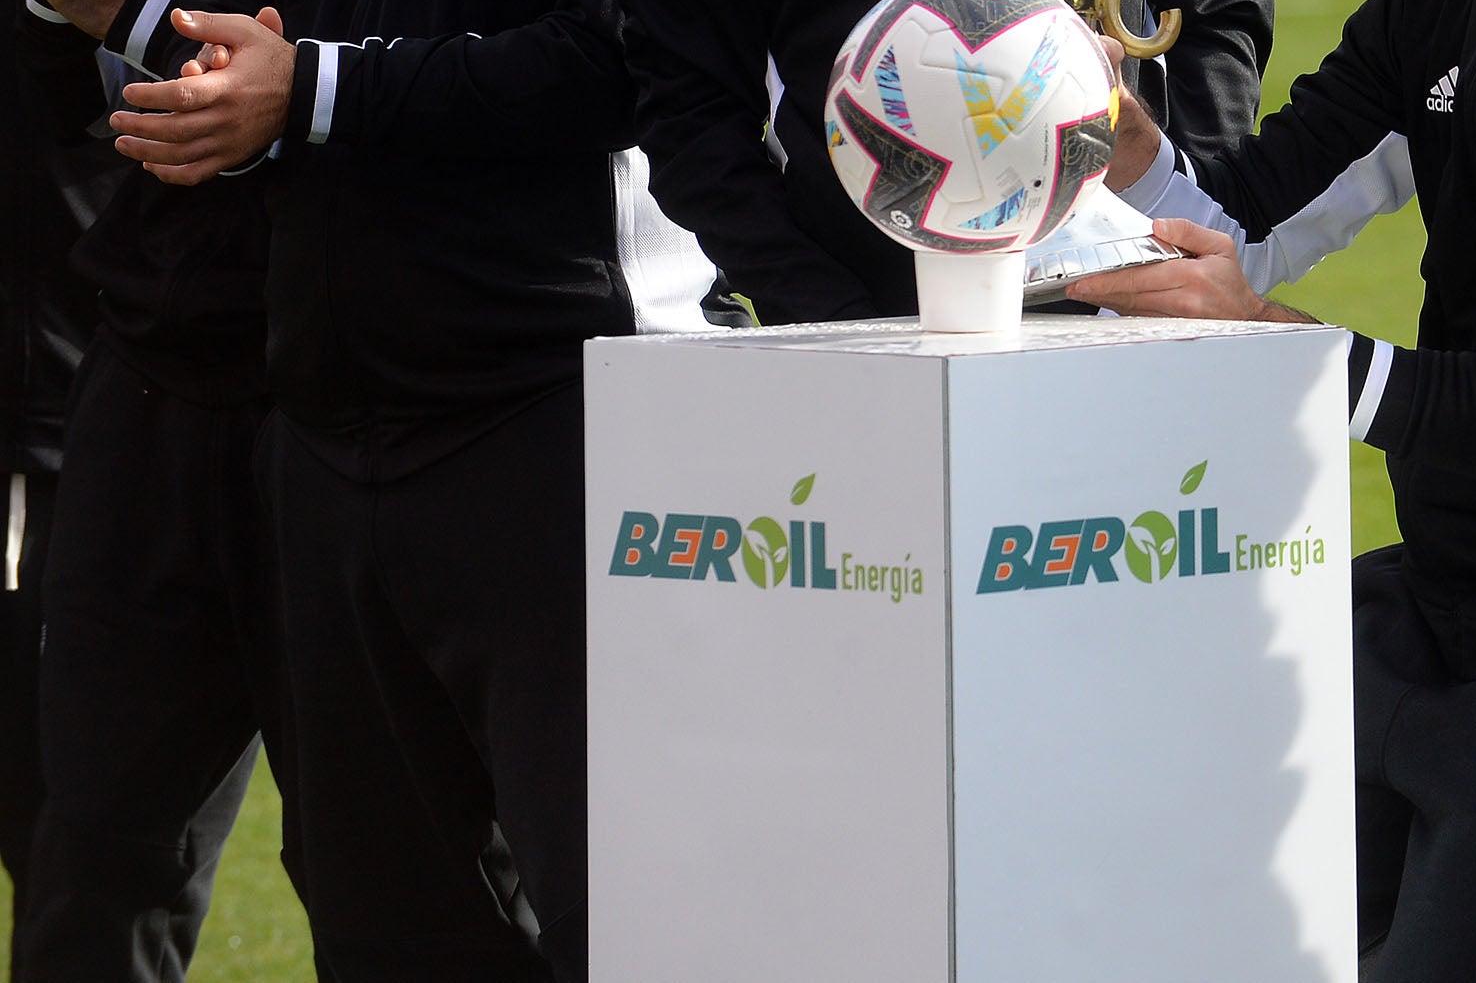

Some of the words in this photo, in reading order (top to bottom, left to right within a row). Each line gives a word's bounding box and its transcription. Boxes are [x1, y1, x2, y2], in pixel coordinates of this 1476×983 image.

[608, 511, 837, 590] BEROIL
[841, 553, 923, 603] Energía
[976, 507, 1231, 595] BEROIL
[1235, 525, 1325, 577] Energía
